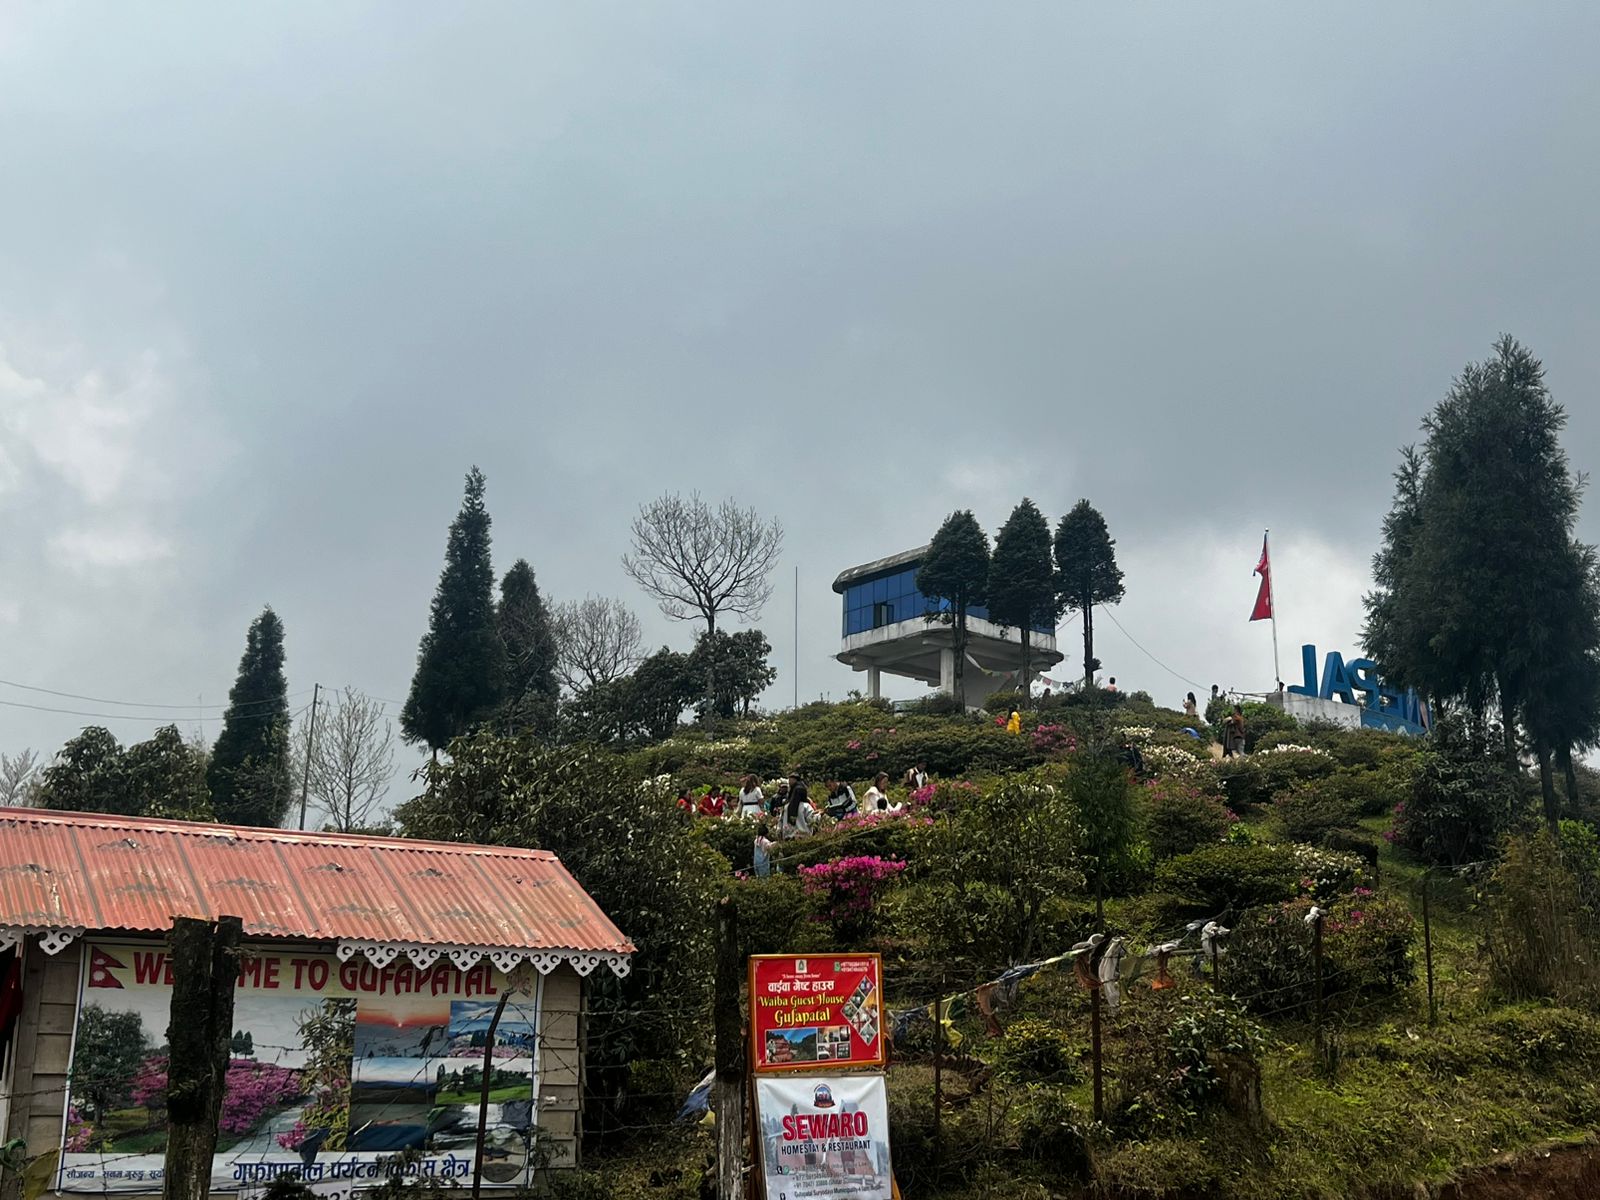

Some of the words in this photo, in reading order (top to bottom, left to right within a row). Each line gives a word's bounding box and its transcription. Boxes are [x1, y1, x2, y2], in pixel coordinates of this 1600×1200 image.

[133, 952, 281, 988] WEME
[290, 958, 329, 991] TO
[339, 961, 497, 997] GUFAPATAL
[812, 980, 835, 992] हाउस
[758, 995, 788, 1007] Waiba
[790, 995, 815, 1008] Guest
[816, 992, 845, 1005] House
[774, 1007, 831, 1028] Gufapatal
[782, 1111, 869, 1141] SEWARO
[781, 1143, 819, 1155] HOMESTAY
[821, 1143, 827, 1152] &
[828, 1140, 871, 1151] RESTAURANT
[331, 1157, 380, 1179] पर्यटन
[441, 1154, 470, 1178] क्षेत्र
